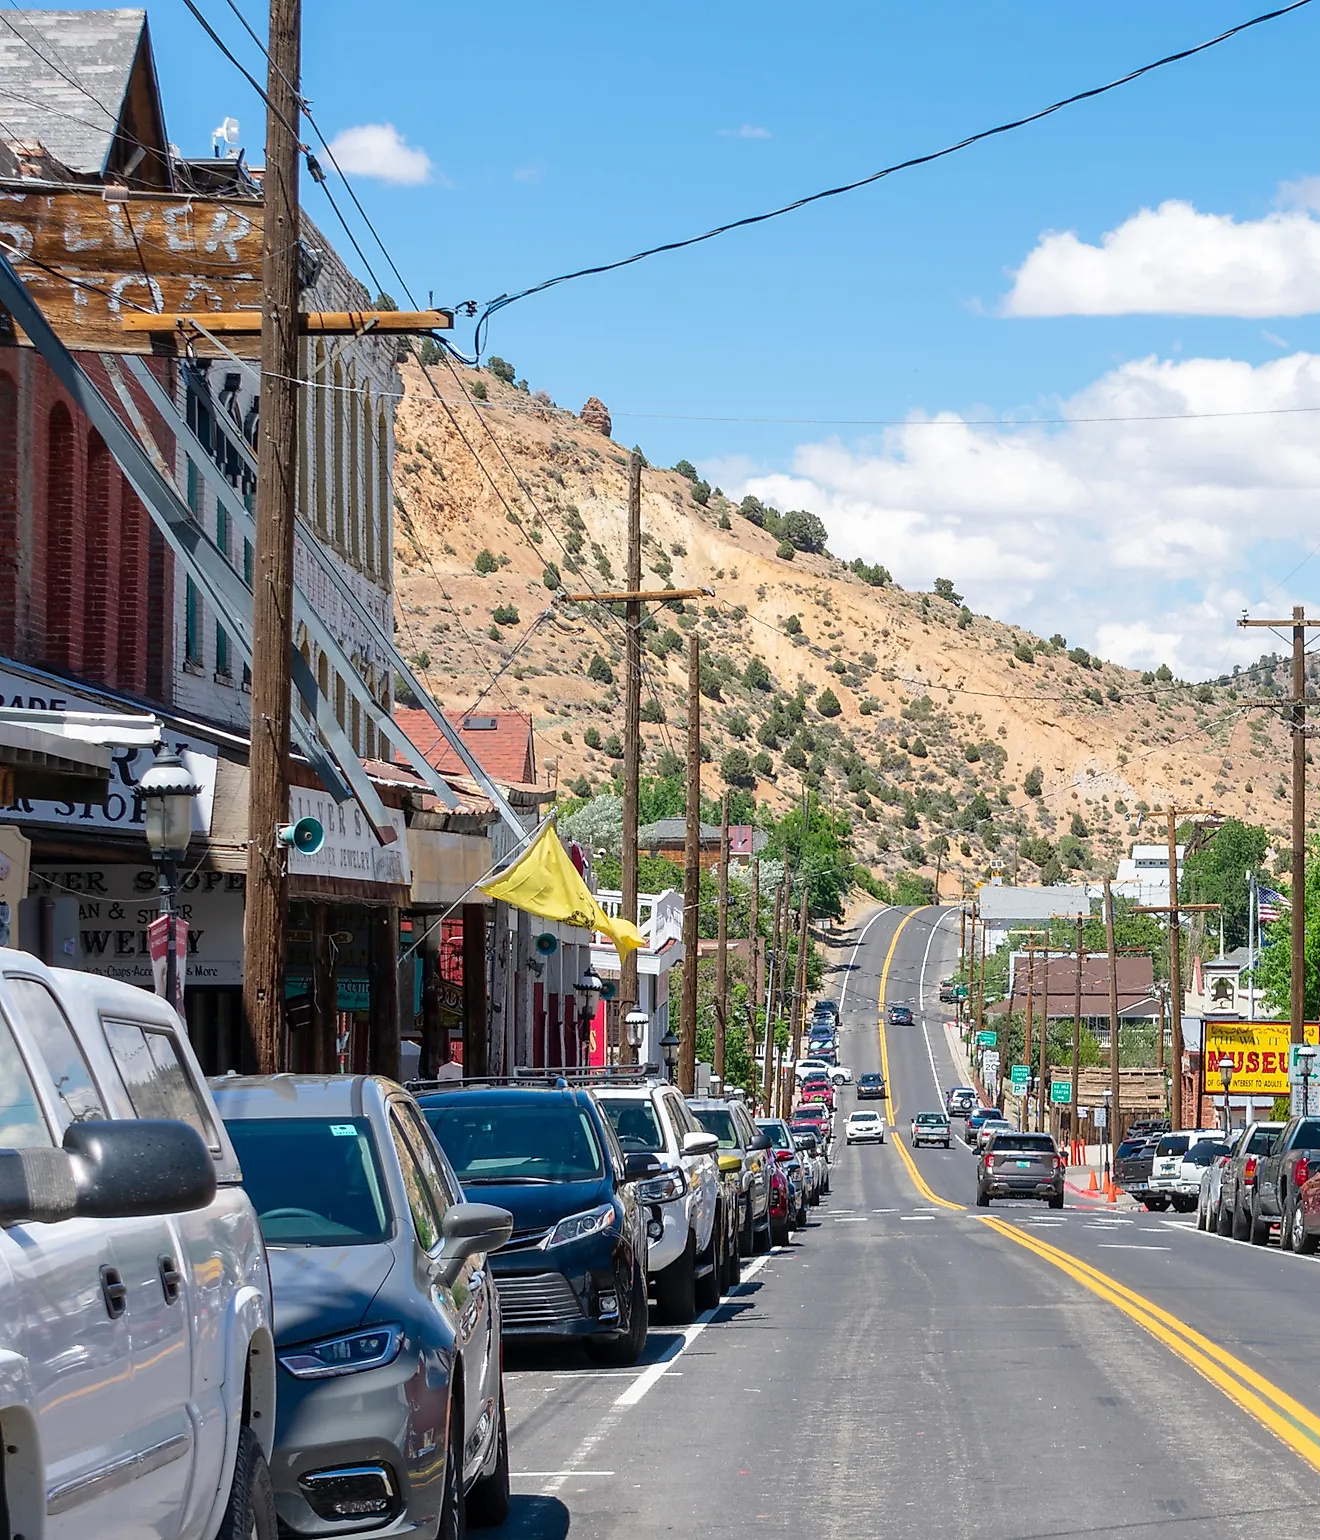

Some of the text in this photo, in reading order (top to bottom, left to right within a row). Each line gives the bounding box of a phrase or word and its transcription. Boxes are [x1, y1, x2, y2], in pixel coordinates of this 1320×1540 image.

[108, 902, 126, 919] &
[195, 962, 218, 977] More
[1212, 1036, 1235, 1046] THE
[1239, 1036, 1261, 1046] WAY
[1208, 1051, 1289, 1074] MUSEU
[1207, 1079, 1214, 1087] OF
[1232, 1079, 1254, 1088] INTEREST
[1264, 1080, 1283, 1088] ADULTS
